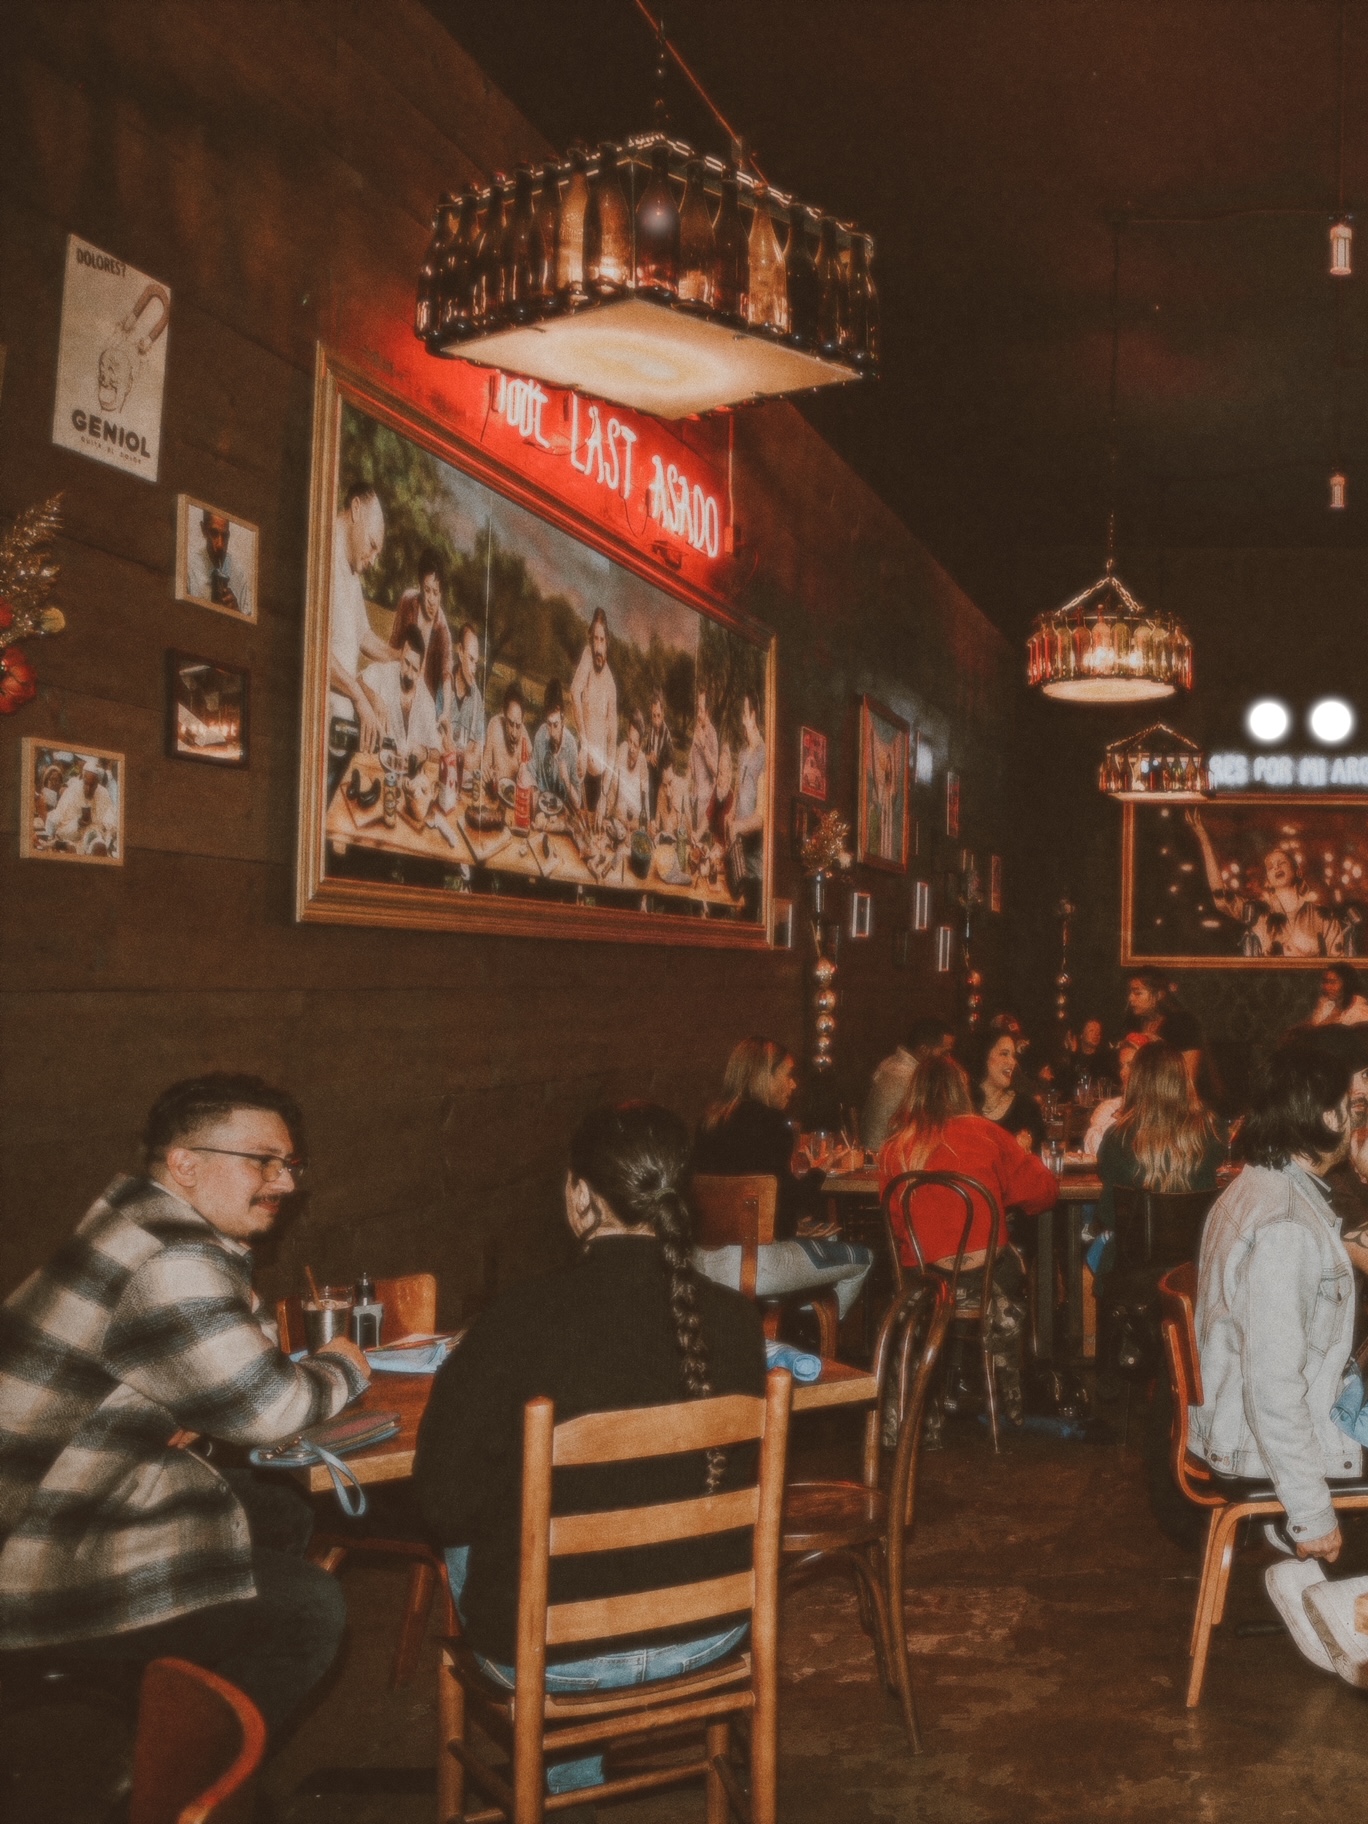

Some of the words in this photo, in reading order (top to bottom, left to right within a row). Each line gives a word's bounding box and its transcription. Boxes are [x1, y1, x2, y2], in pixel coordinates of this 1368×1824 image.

[76, 248, 126, 278] DOLORES?
[71, 409, 150, 459] GENIOL
[570, 391, 637, 500] LAST
[650, 454, 719, 559] ASADO
